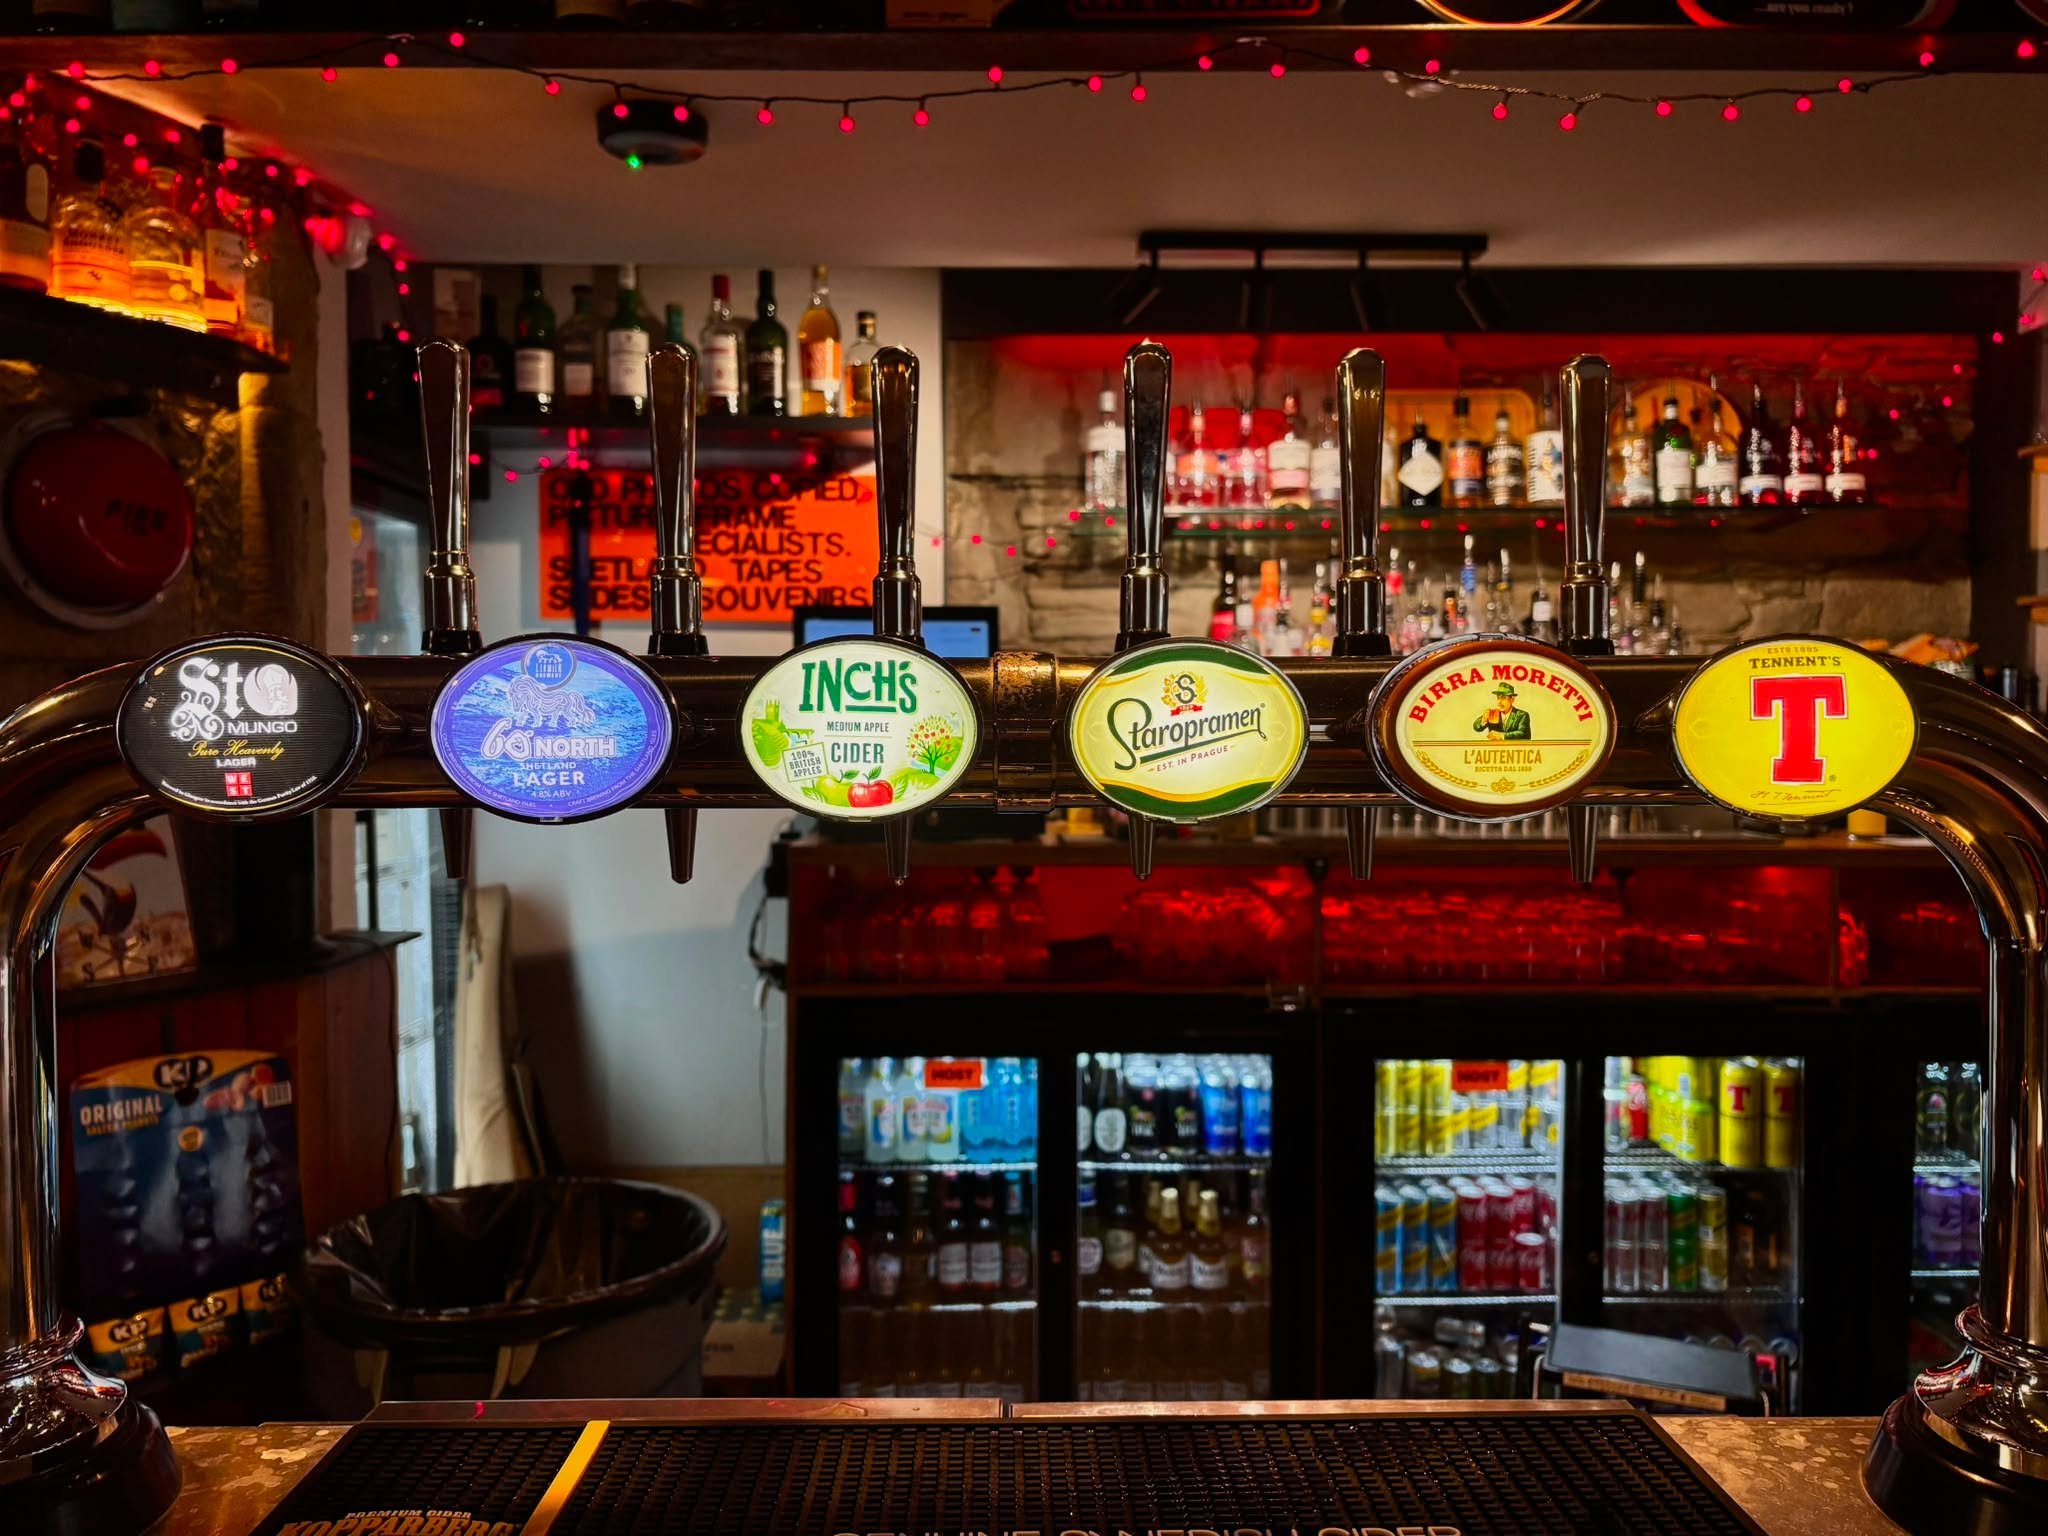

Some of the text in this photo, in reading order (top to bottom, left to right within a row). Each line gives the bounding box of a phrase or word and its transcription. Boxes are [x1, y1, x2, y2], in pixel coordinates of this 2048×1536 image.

[549, 476, 608, 501] OD
[690, 530, 852, 557] ECIALISTS.
[730, 558, 823, 584] TAPES
[549, 584, 651, 612] SDES
[1749, 656, 1842, 669] TENNENT'S
[171, 656, 245, 742] St
[1408, 664, 1594, 724] BIRRA MORETTI
[227, 720, 298, 735] MUNGO
[826, 720, 889, 733] MEDIUM APPLE
[1107, 698, 1267, 771] Staropramen
[1750, 673, 1849, 786] T
[188, 739, 286, 760] Pure Heavenly
[534, 734, 617, 759] NORTH
[791, 749, 815, 761] 100%
[830, 742, 885, 764] CIDER
[1463, 749, 1542, 765] L'AUTENTICA
[216, 757, 257, 769] LAGER
[520, 761, 577, 770] SHETLAND
[789, 757, 821, 771] BRITISH
[1156, 744, 1229, 772] EST. IN PRAGUE
[513, 771, 586, 786] LAGER
[793, 765, 823, 778] APPLES
[553, 789, 572, 798] ABV
[1728, 1084, 1750, 1113] T
[80, 1094, 163, 1126] ORIGINAL
[190, 1298, 225, 1321] KP
[112, 1318, 148, 1342] KP
[347, 1509, 471, 1519] PREMIUM CIDER
